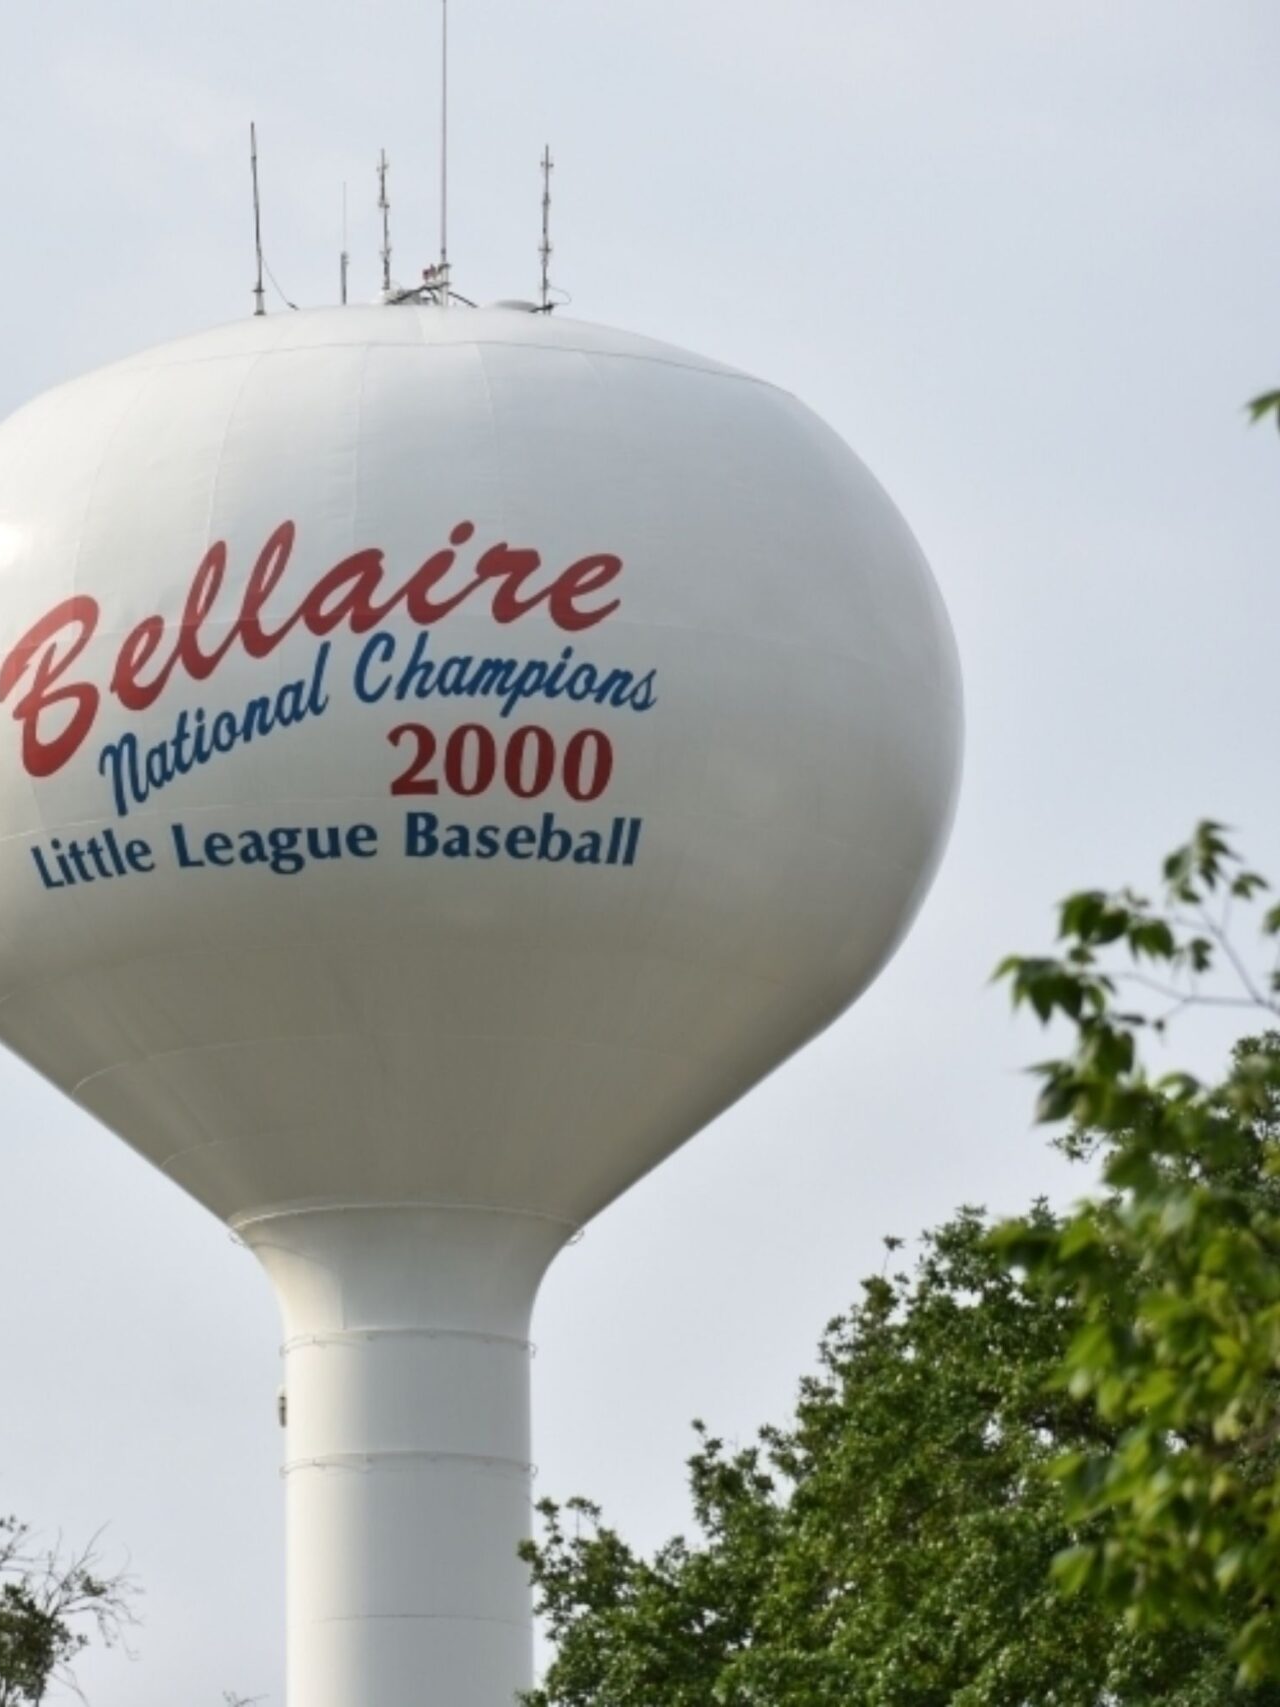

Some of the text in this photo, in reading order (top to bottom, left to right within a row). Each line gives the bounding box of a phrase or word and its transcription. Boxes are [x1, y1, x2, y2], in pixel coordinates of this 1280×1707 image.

[99, 630, 658, 816] National Champions
[387, 722, 613, 802] 2000
[30, 811, 642, 890] Little League Baseball
